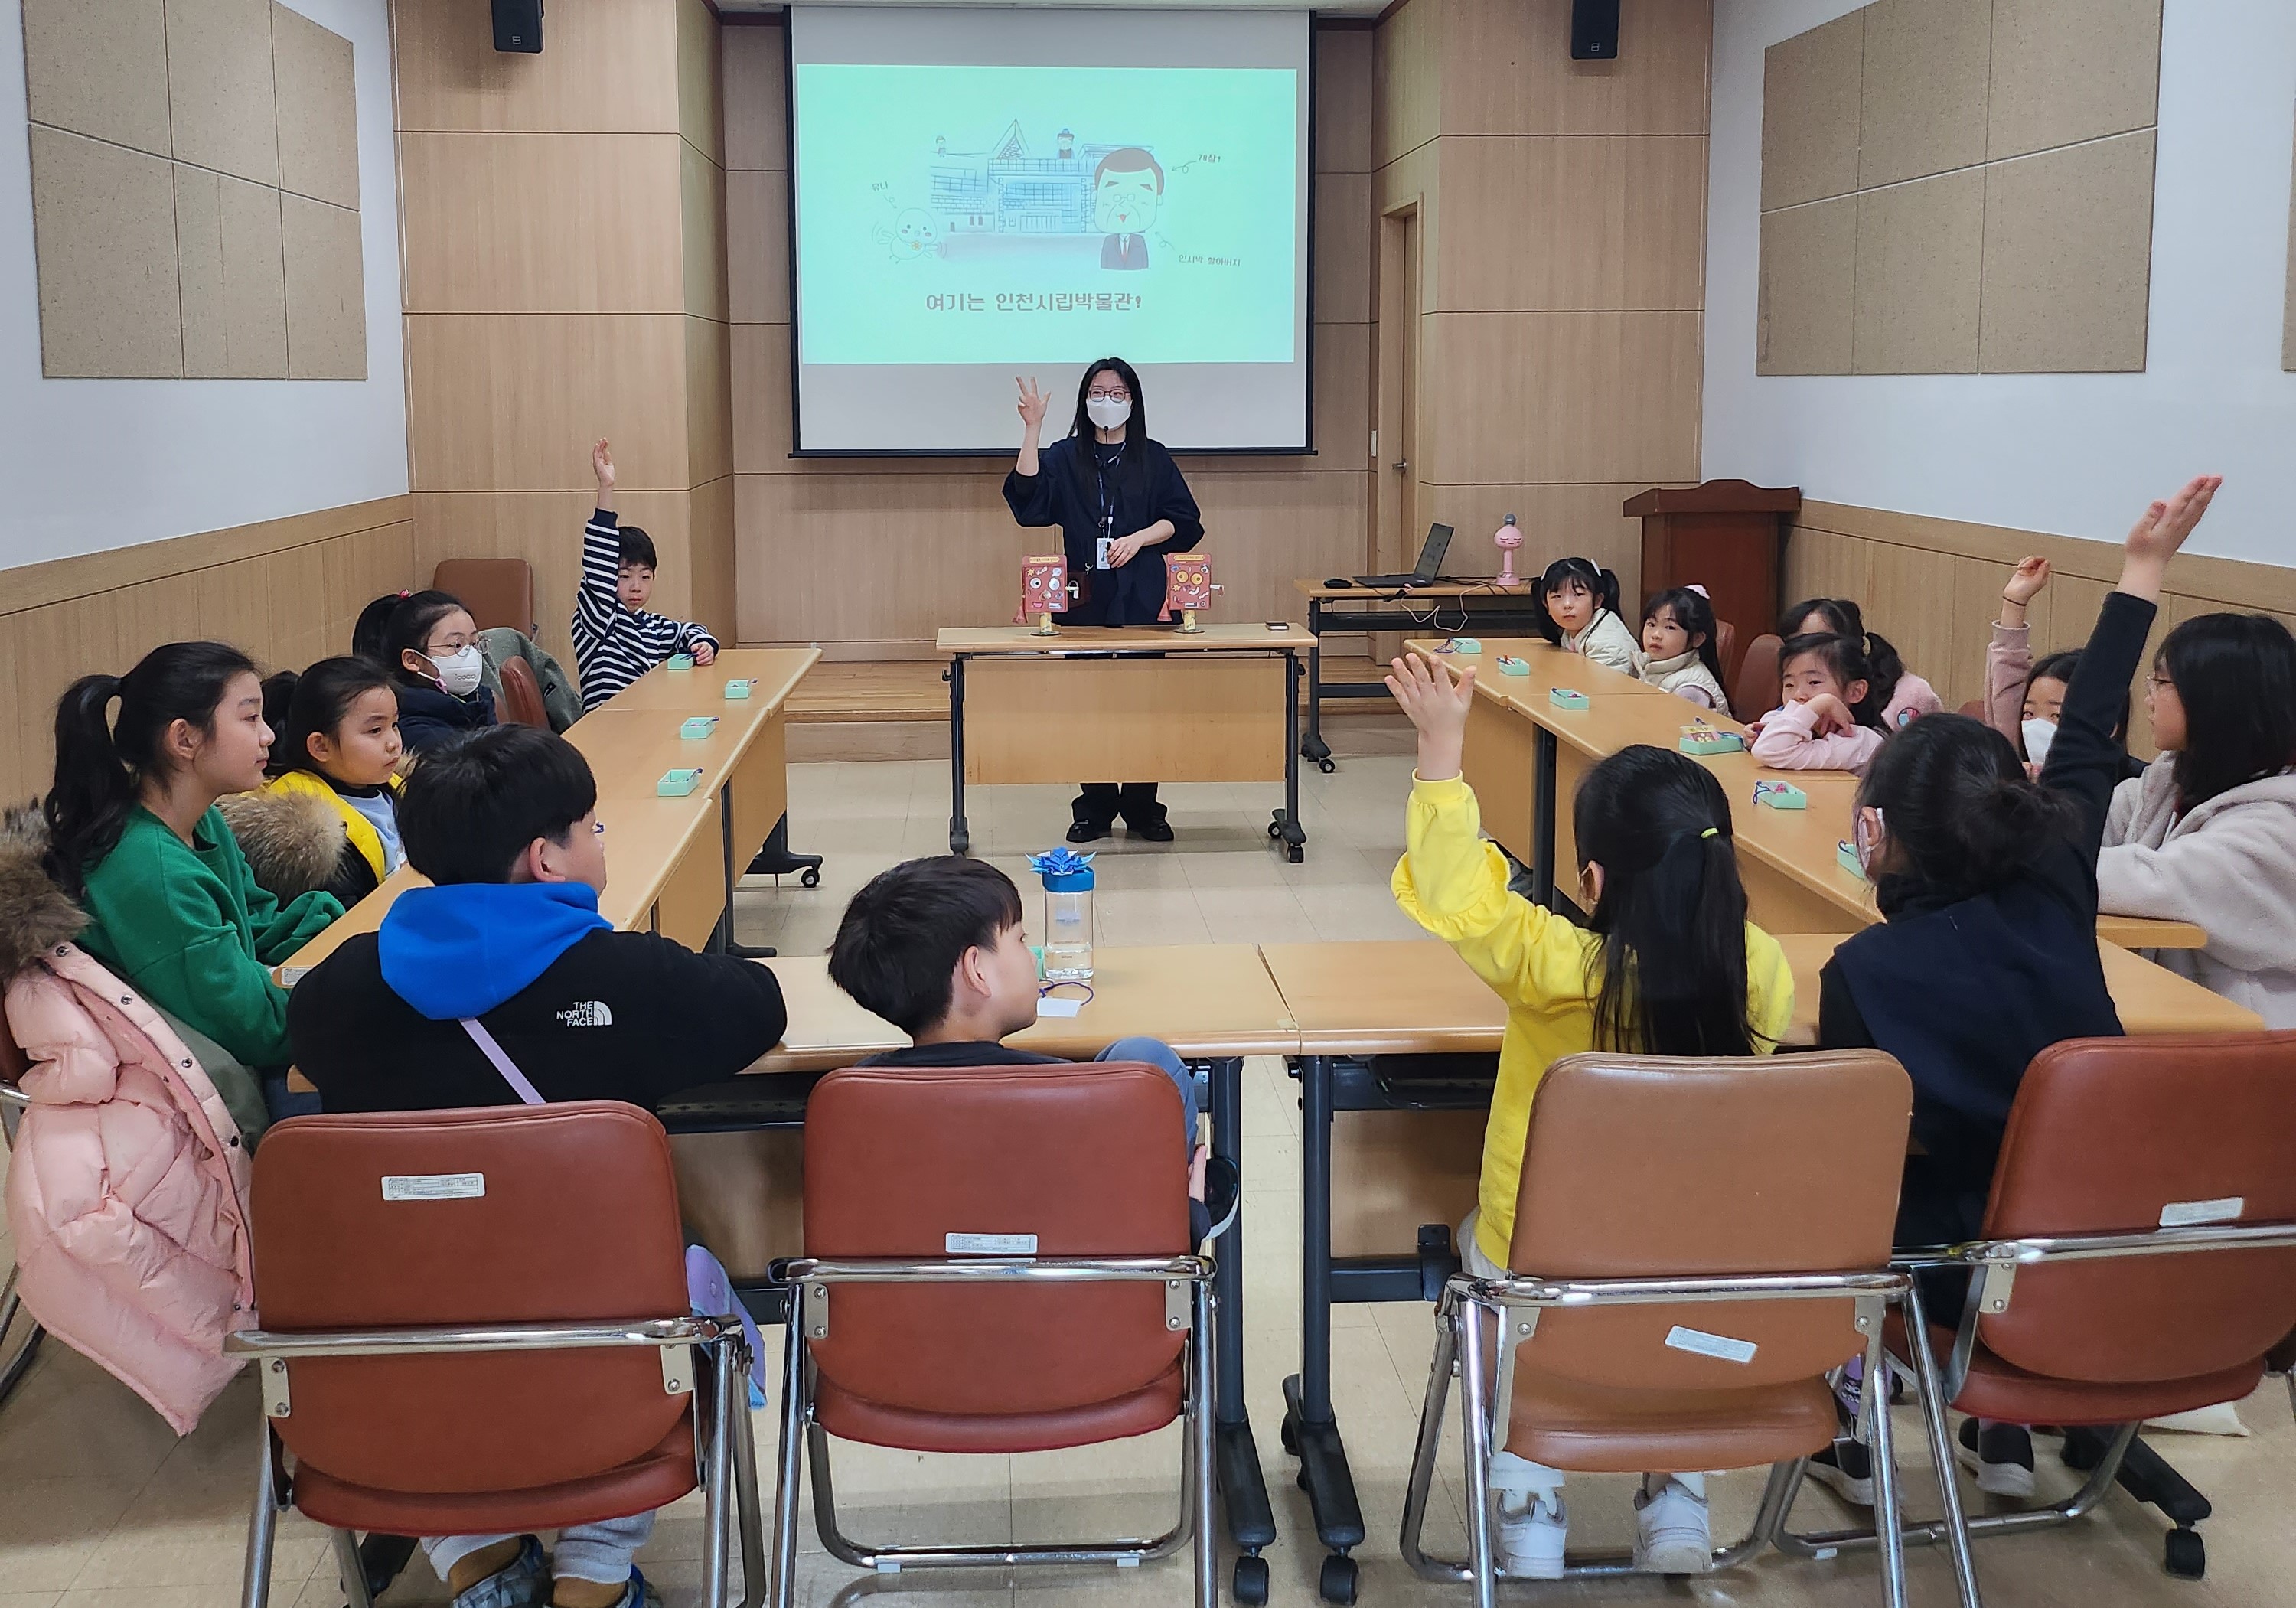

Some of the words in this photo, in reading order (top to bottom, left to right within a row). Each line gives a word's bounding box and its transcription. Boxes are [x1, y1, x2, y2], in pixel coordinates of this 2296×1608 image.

[926, 293, 986, 311] 여기는
[995, 292, 1143, 312] 인천시립박물관!
[573, 1001, 593, 1010] THE
[556, 1009, 593, 1019] NORTH
[567, 1018, 593, 1026] FACE
